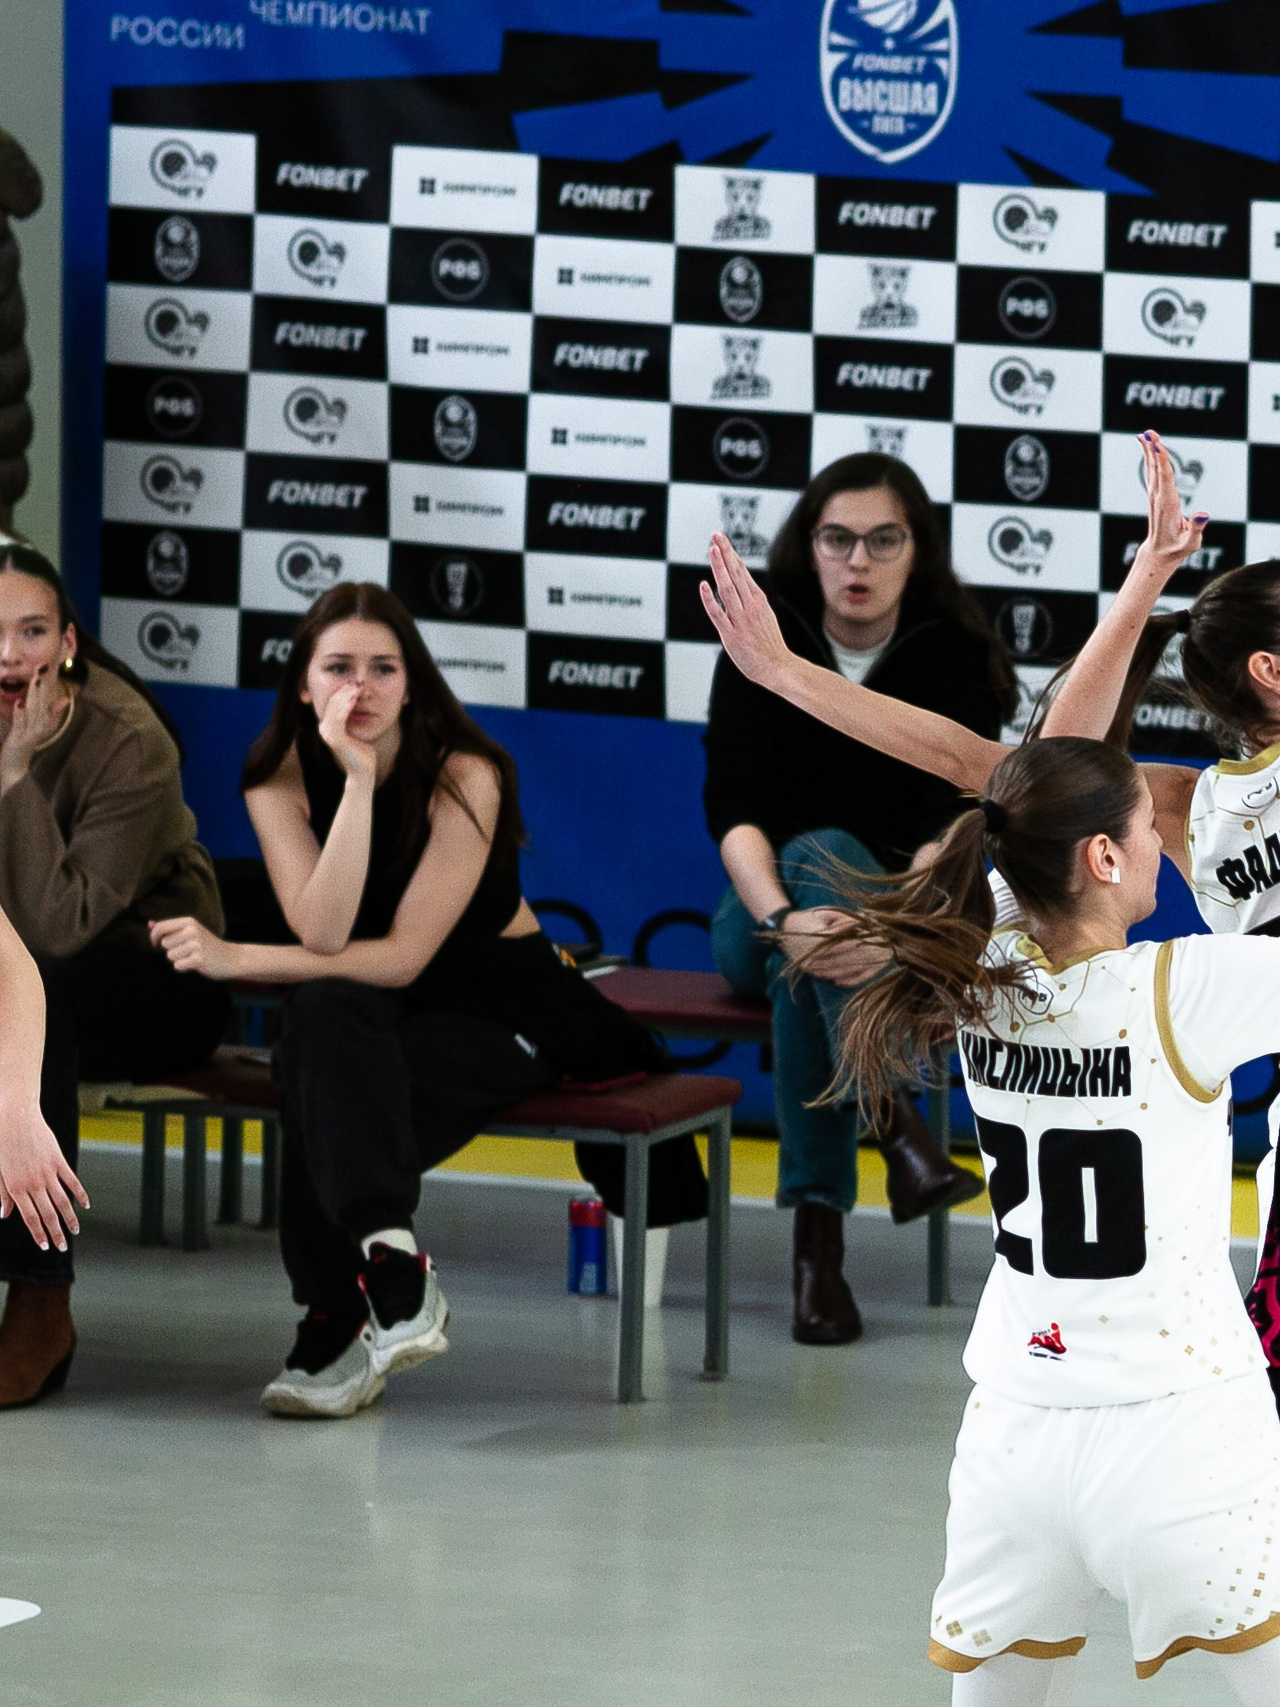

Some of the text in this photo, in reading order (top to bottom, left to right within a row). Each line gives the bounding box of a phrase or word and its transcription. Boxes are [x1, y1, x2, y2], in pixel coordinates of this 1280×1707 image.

[110, 13, 246, 49] РОССИИ
[250, 0, 430, 35] ЧЕМПИОНАТ
[838, 77, 938, 115] ВЫСШАЯ
[276, 162, 370, 192] FONBET
[558, 182, 653, 211] FONBET
[838, 201, 937, 230] FONBET
[1127, 219, 1228, 248] FONBET
[275, 321, 367, 351] FONBET
[553, 343, 649, 372] FONBET
[836, 362, 932, 391] FONBET
[1125, 381, 1225, 410] FONBET
[267, 479, 367, 509] FONBET
[547, 502, 646, 531] FONBET
[548, 660, 644, 689] FONBET
[974, 1115, 1147, 1280] 20
